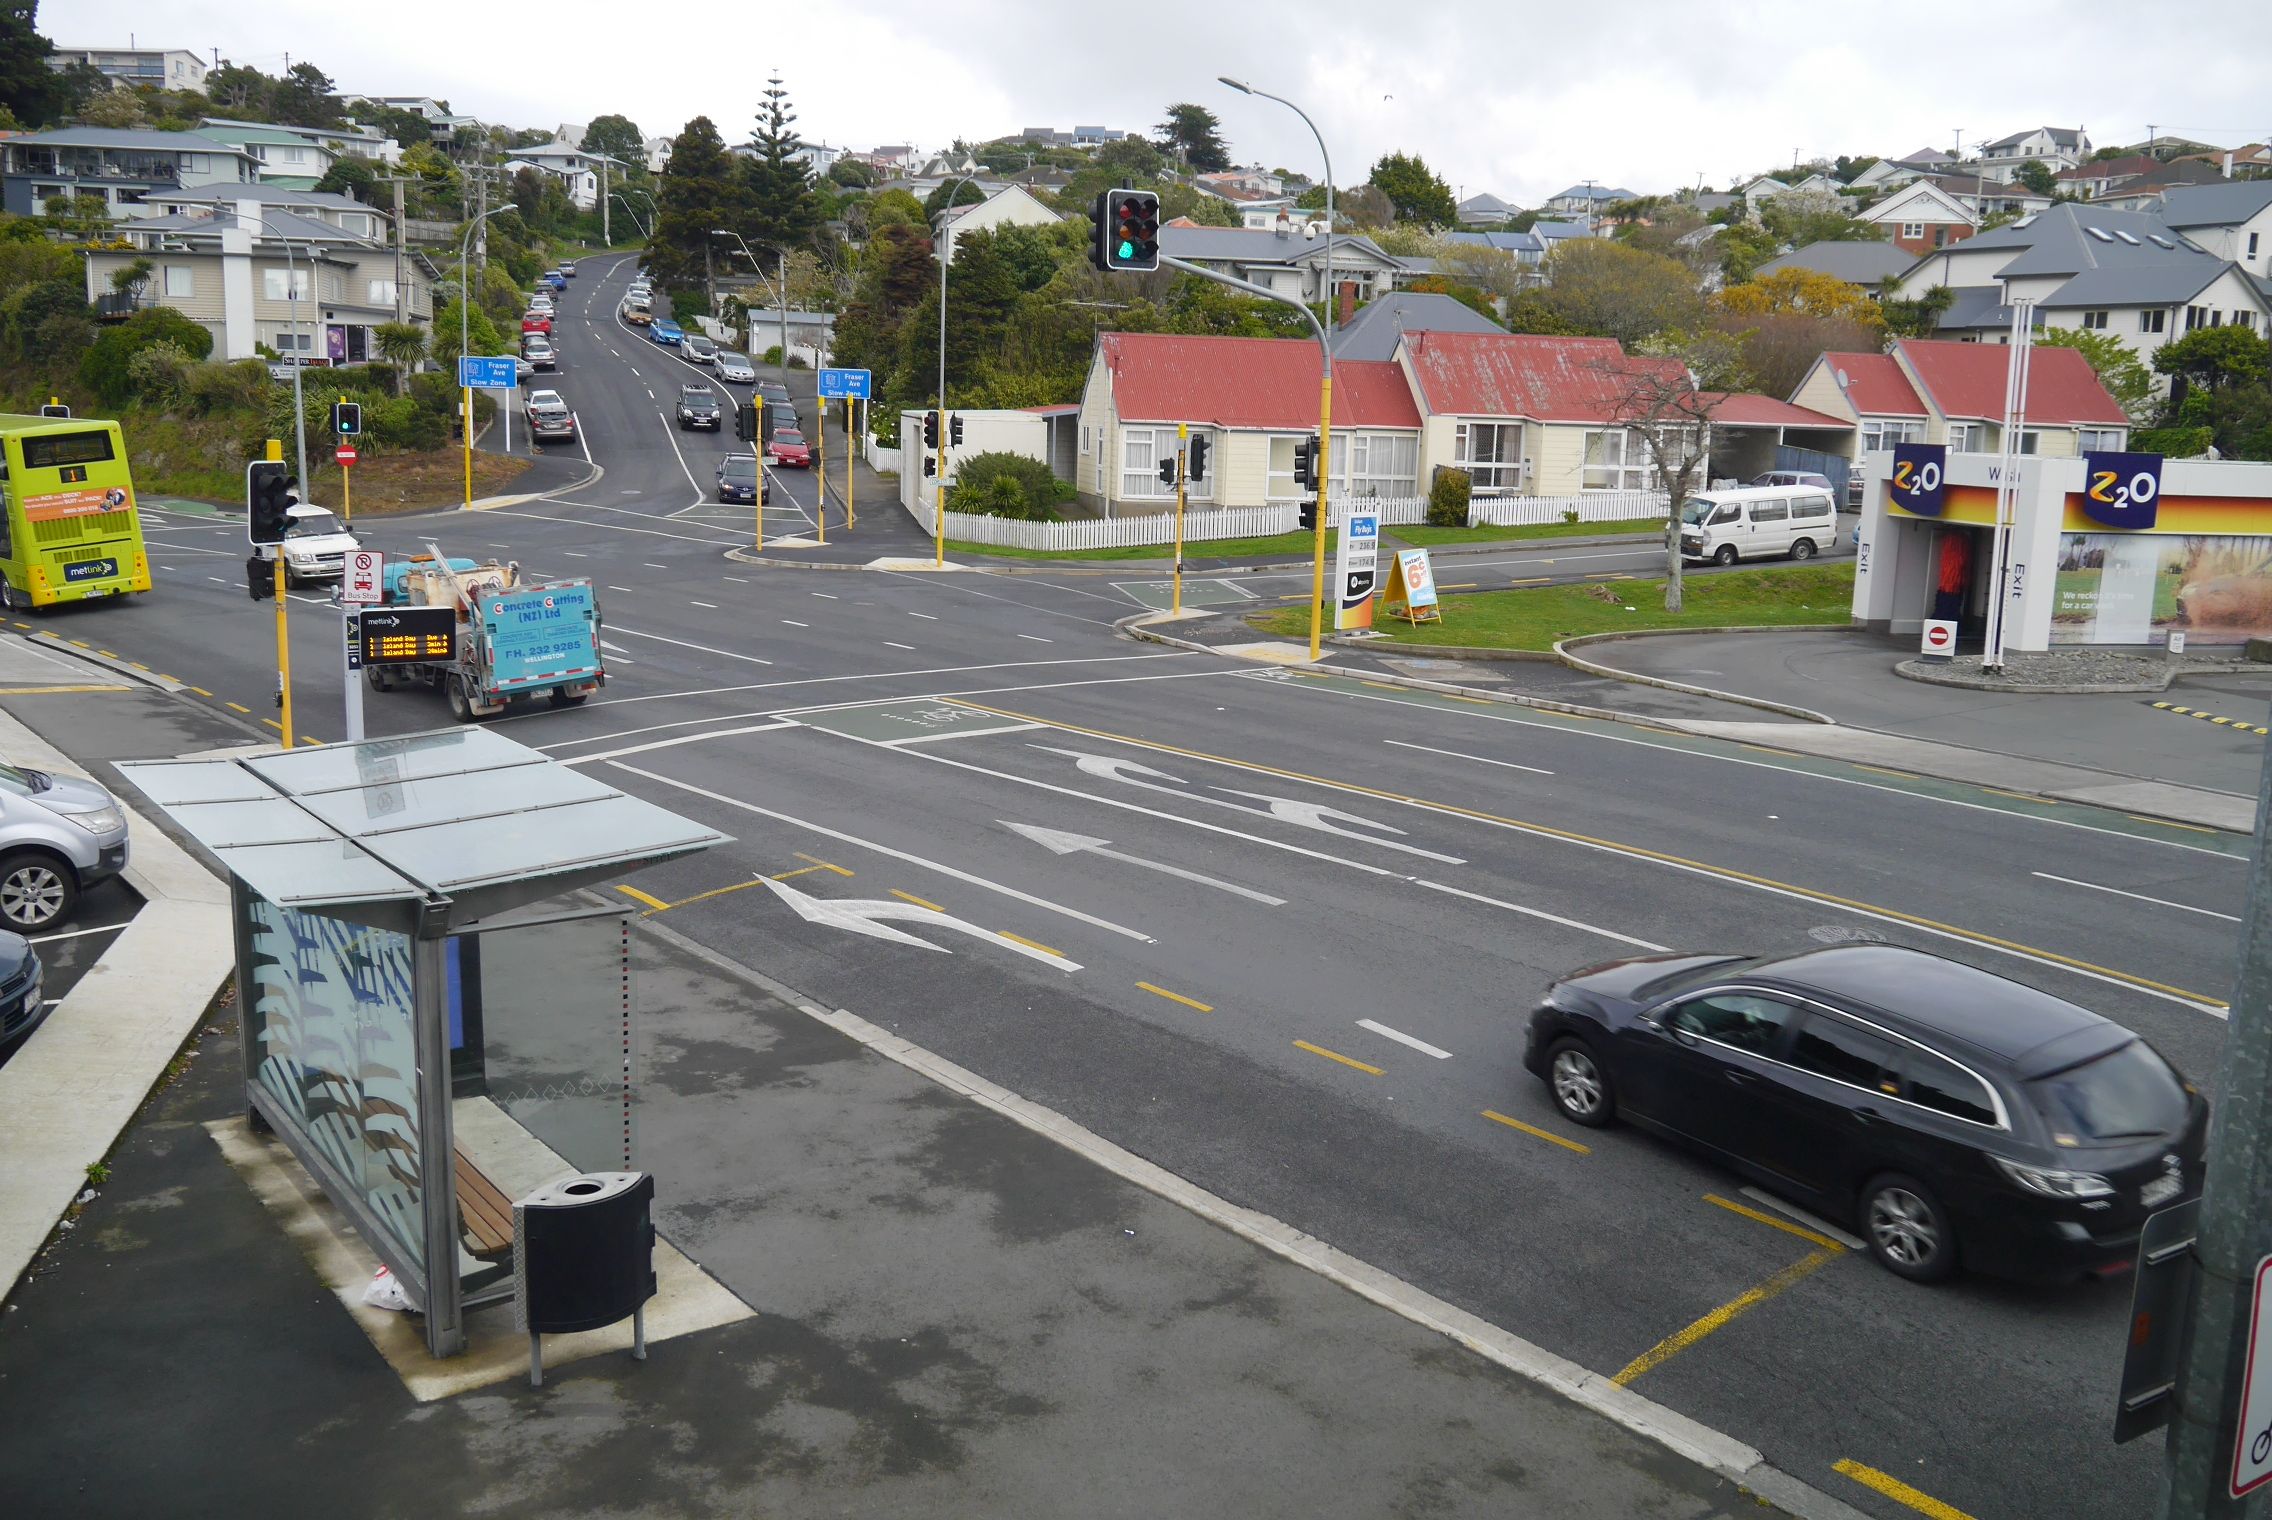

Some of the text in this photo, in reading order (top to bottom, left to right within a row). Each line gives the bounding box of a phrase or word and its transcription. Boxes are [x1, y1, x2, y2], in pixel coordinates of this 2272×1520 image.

[488, 361, 510, 369] Fraser
[470, 378, 488, 386] Slow
[844, 373, 865, 381] Fraser
[69, 468, 77, 482] 1
[1860, 543, 1870, 574] Exit
[70, 564, 103, 576] metlink
[2012, 563, 2025, 599] Exit
[362, 592, 379, 601] Stop
[2063, 591, 2076, 600] We
[494, 594, 584, 614] Concrete Cutting
[2061, 601, 2073, 609] for
[518, 609, 561, 623] (NZ) Ltd
[368, 617, 393, 626] metlink
[529, 645, 551, 656] 232
[553, 641, 581, 652] 9285
[525, 653, 566, 663] WELLINGTON
